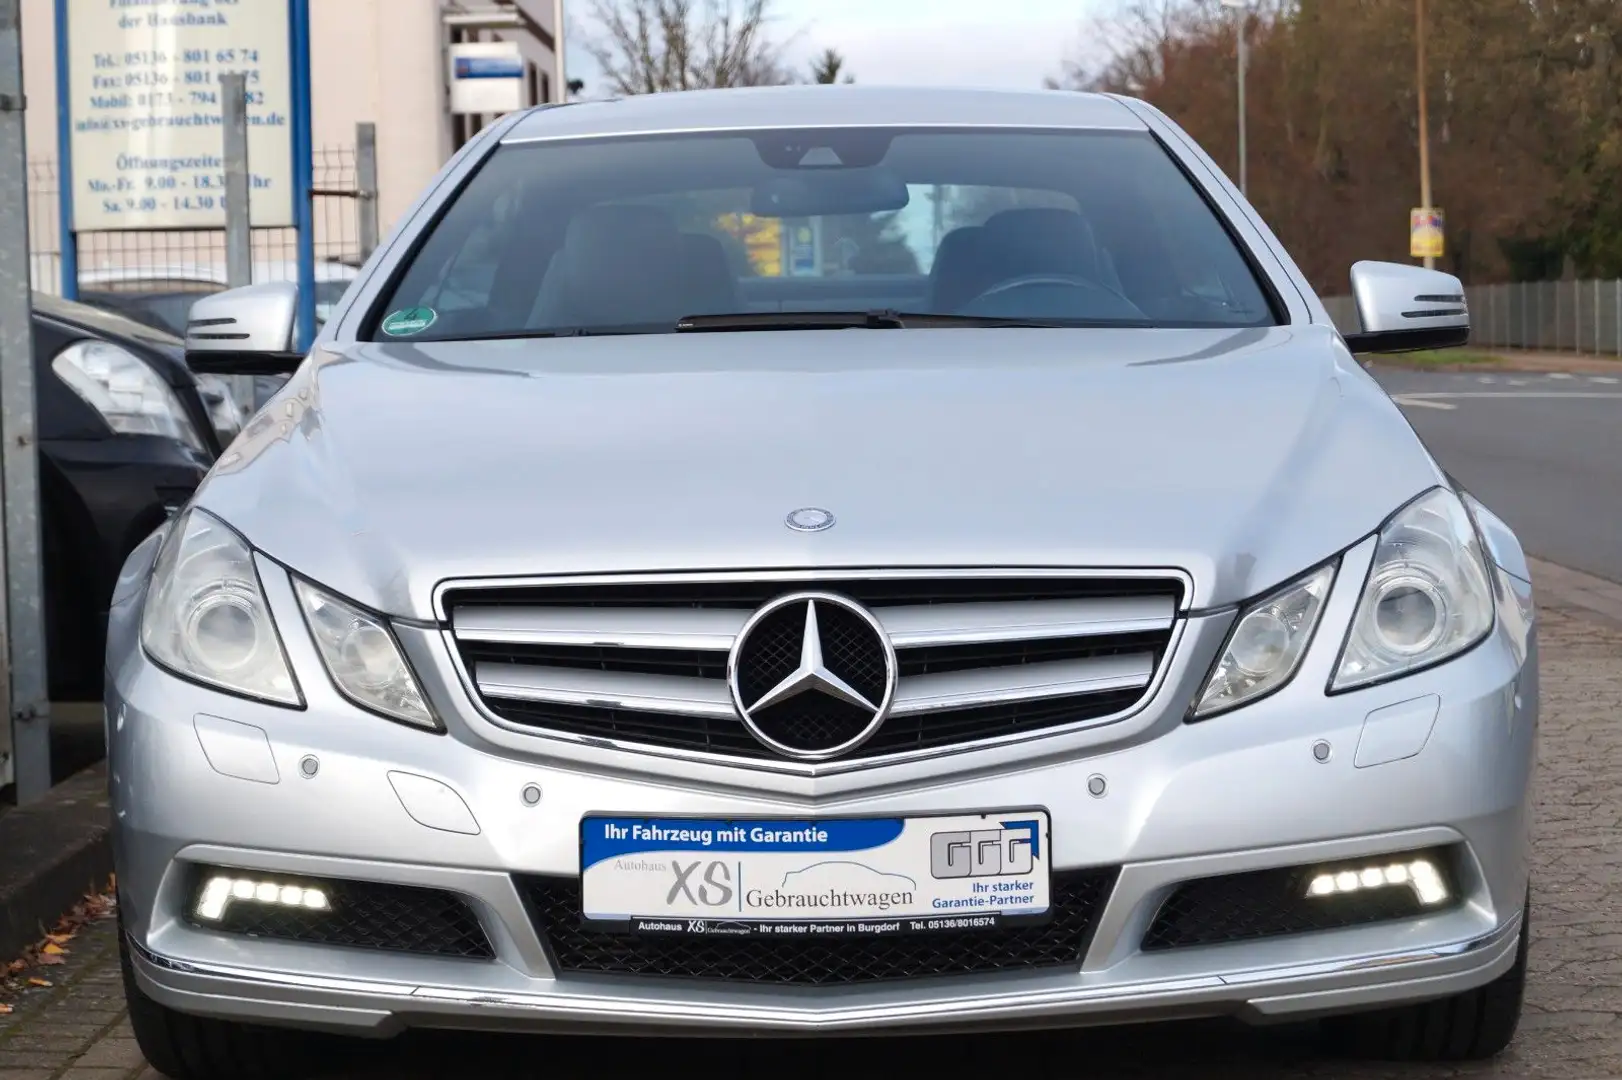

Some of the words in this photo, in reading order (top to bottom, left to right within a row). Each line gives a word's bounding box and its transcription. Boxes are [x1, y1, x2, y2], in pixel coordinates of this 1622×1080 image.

[183, 49, 210, 63] 801
[216, 50, 235, 63] 65
[241, 49, 258, 63] 74
[184, 70, 211, 84] 801
[188, 91, 216, 105] 794
[145, 175, 175, 189] 9.00
[173, 196, 214, 211] 14.30
[604, 824, 628, 840] Ihr
[633, 825, 712, 845] Fahrzeug
[717, 827, 747, 842] mit
[750, 827, 828, 843] Garantie
[614, 859, 667, 872] Autohaus
[666, 860, 733, 906] XS
[972, 882, 990, 893] Ihr
[992, 881, 1034, 892] starker
[746, 889, 913, 910] Gebrauchtwagen
[932, 893, 1035, 909] Garantie-Partner
[638, 921, 683, 931] Autohaus
[687, 920, 705, 933] XS
[760, 923, 772, 933] Ihr
[775, 924, 808, 933] starker
[810, 924, 844, 933] Partner
[858, 922, 900, 934] Burgdorf
[910, 921, 925, 931] Tel.
[928, 917, 995, 930] 05136/8016574
